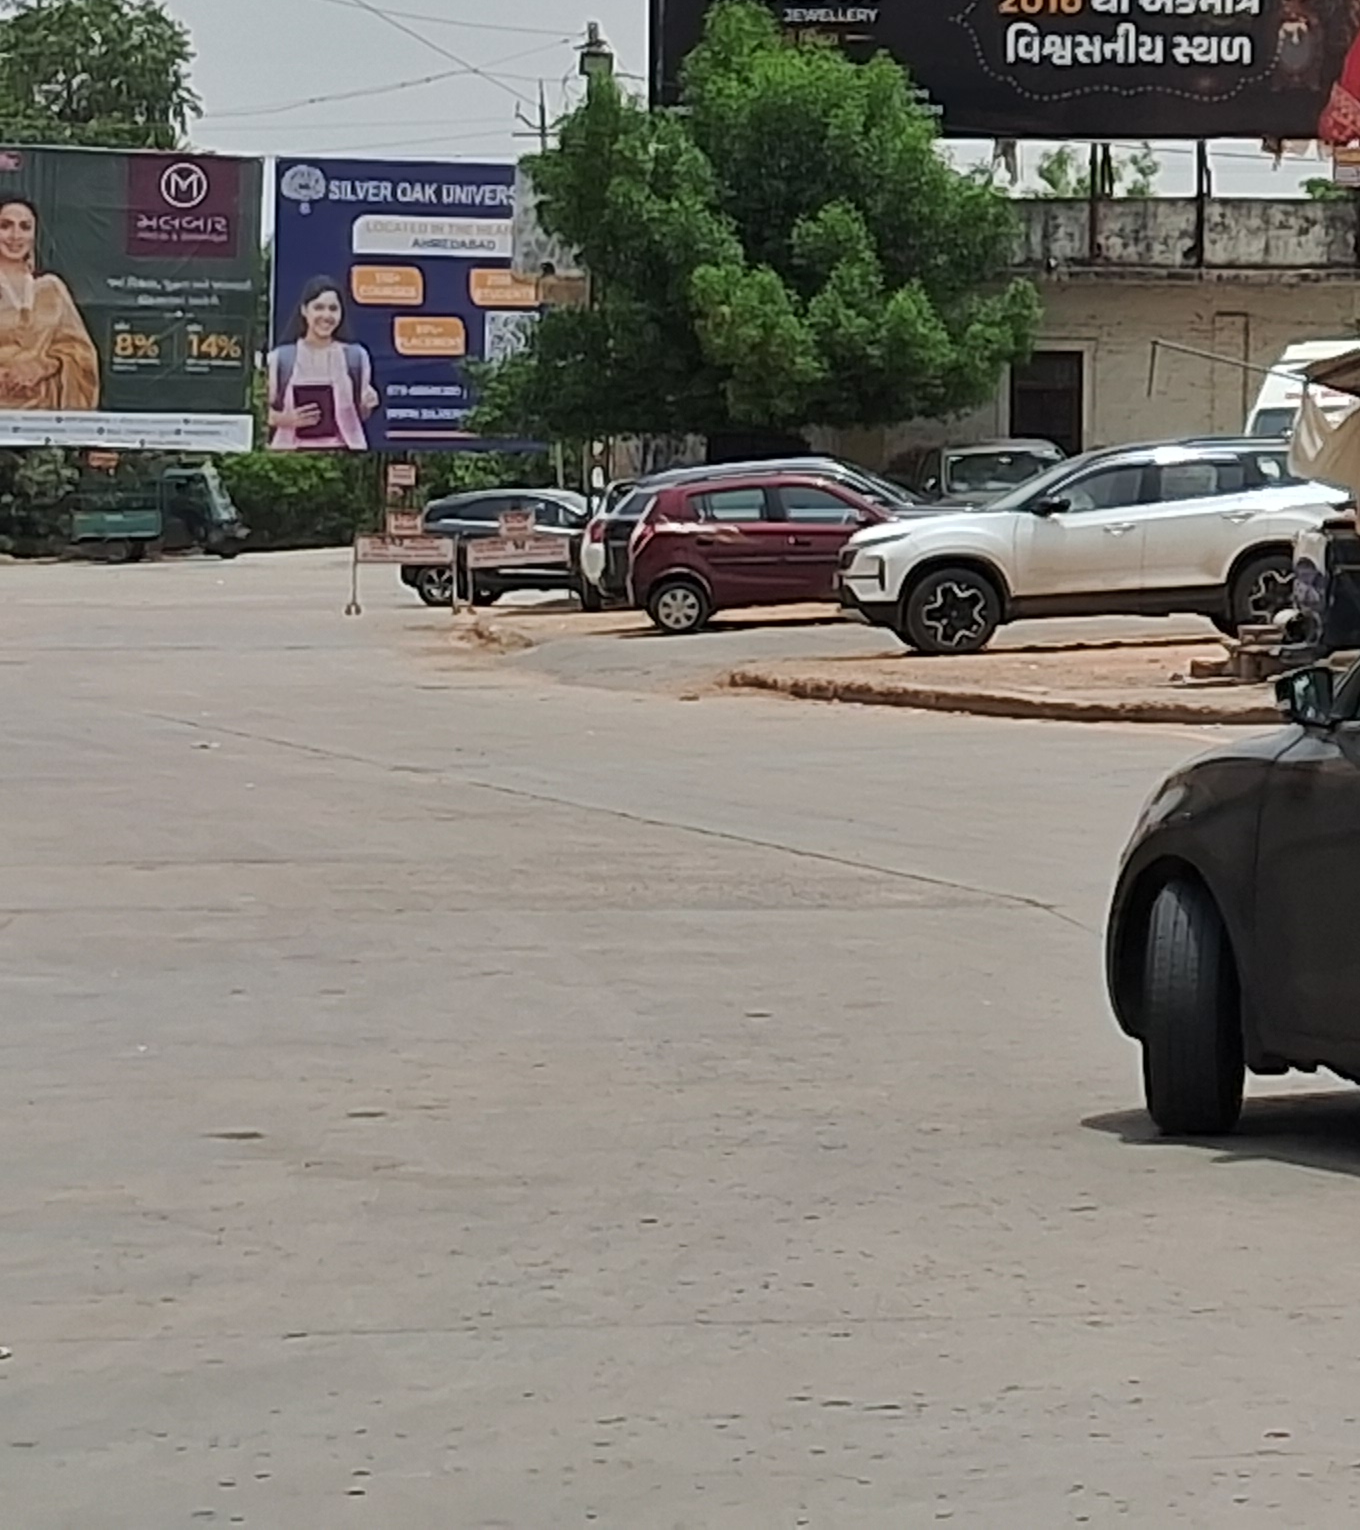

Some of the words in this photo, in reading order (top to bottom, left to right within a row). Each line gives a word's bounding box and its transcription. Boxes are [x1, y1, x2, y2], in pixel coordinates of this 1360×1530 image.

[1006, 21, 1163, 65] વિશ્વસનીય
[1172, 34, 1252, 65] સ્થળ
[328, 179, 393, 202] SILVER
[397, 181, 437, 204] OAK
[136, 214, 228, 233] મલબાર
[114, 333, 160, 357] 8%
[187, 334, 242, 358] 14%
